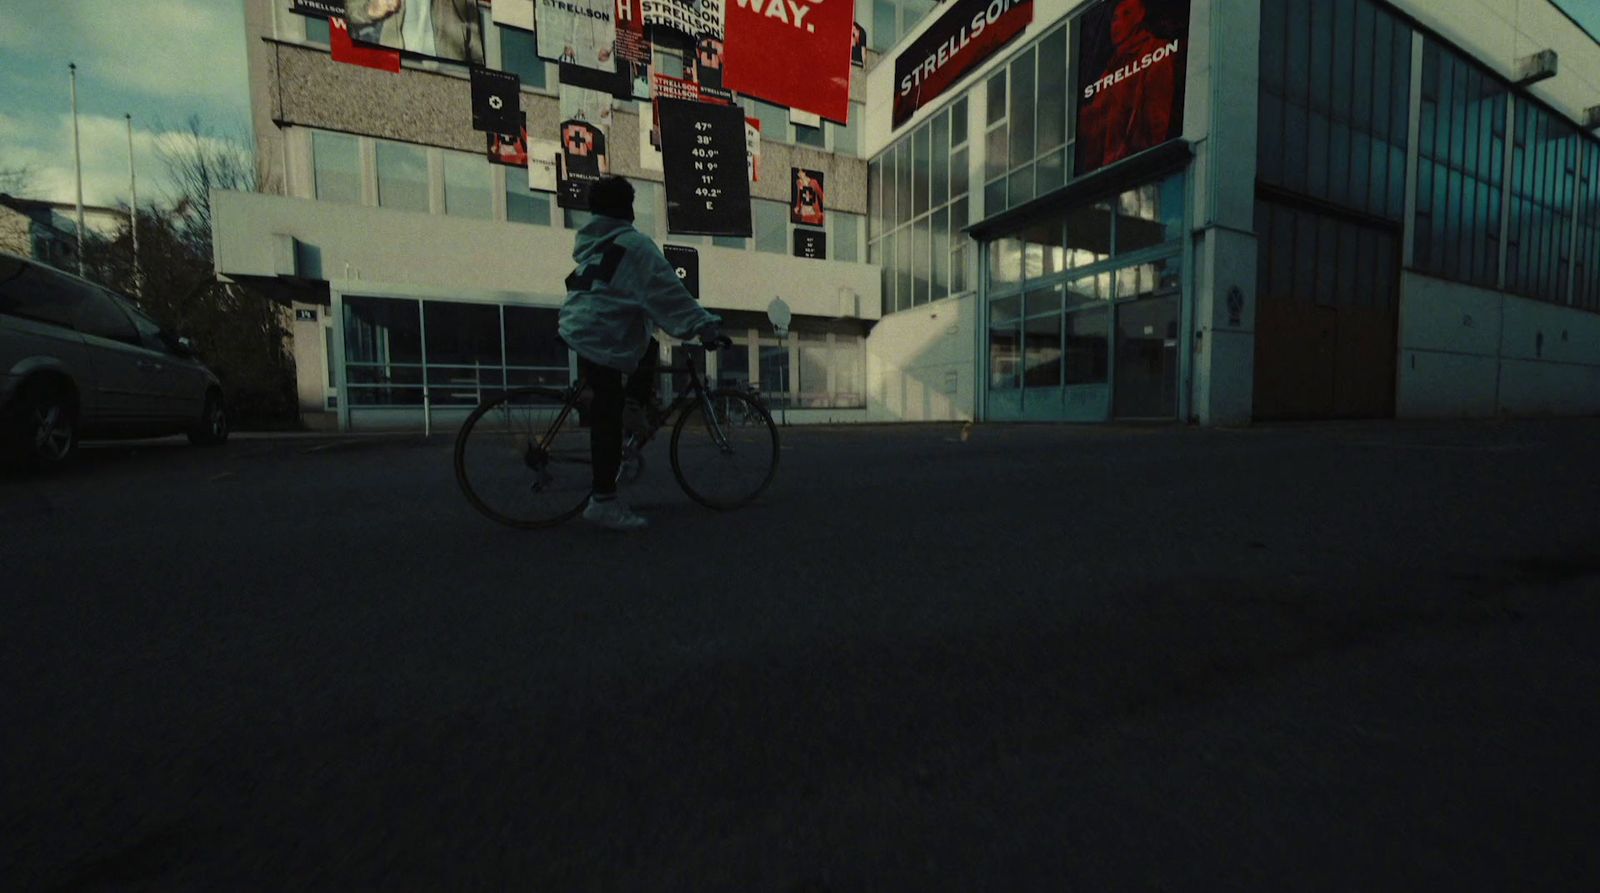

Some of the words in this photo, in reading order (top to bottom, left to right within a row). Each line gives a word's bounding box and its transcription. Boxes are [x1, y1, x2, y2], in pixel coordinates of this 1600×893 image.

[543, 0, 610, 22] STRELLSON
[643, 1, 720, 38] STRELLSON
[1084, 39, 1179, 98] STRELLSON
[695, 161, 703, 170] N
[706, 201, 714, 210] E
